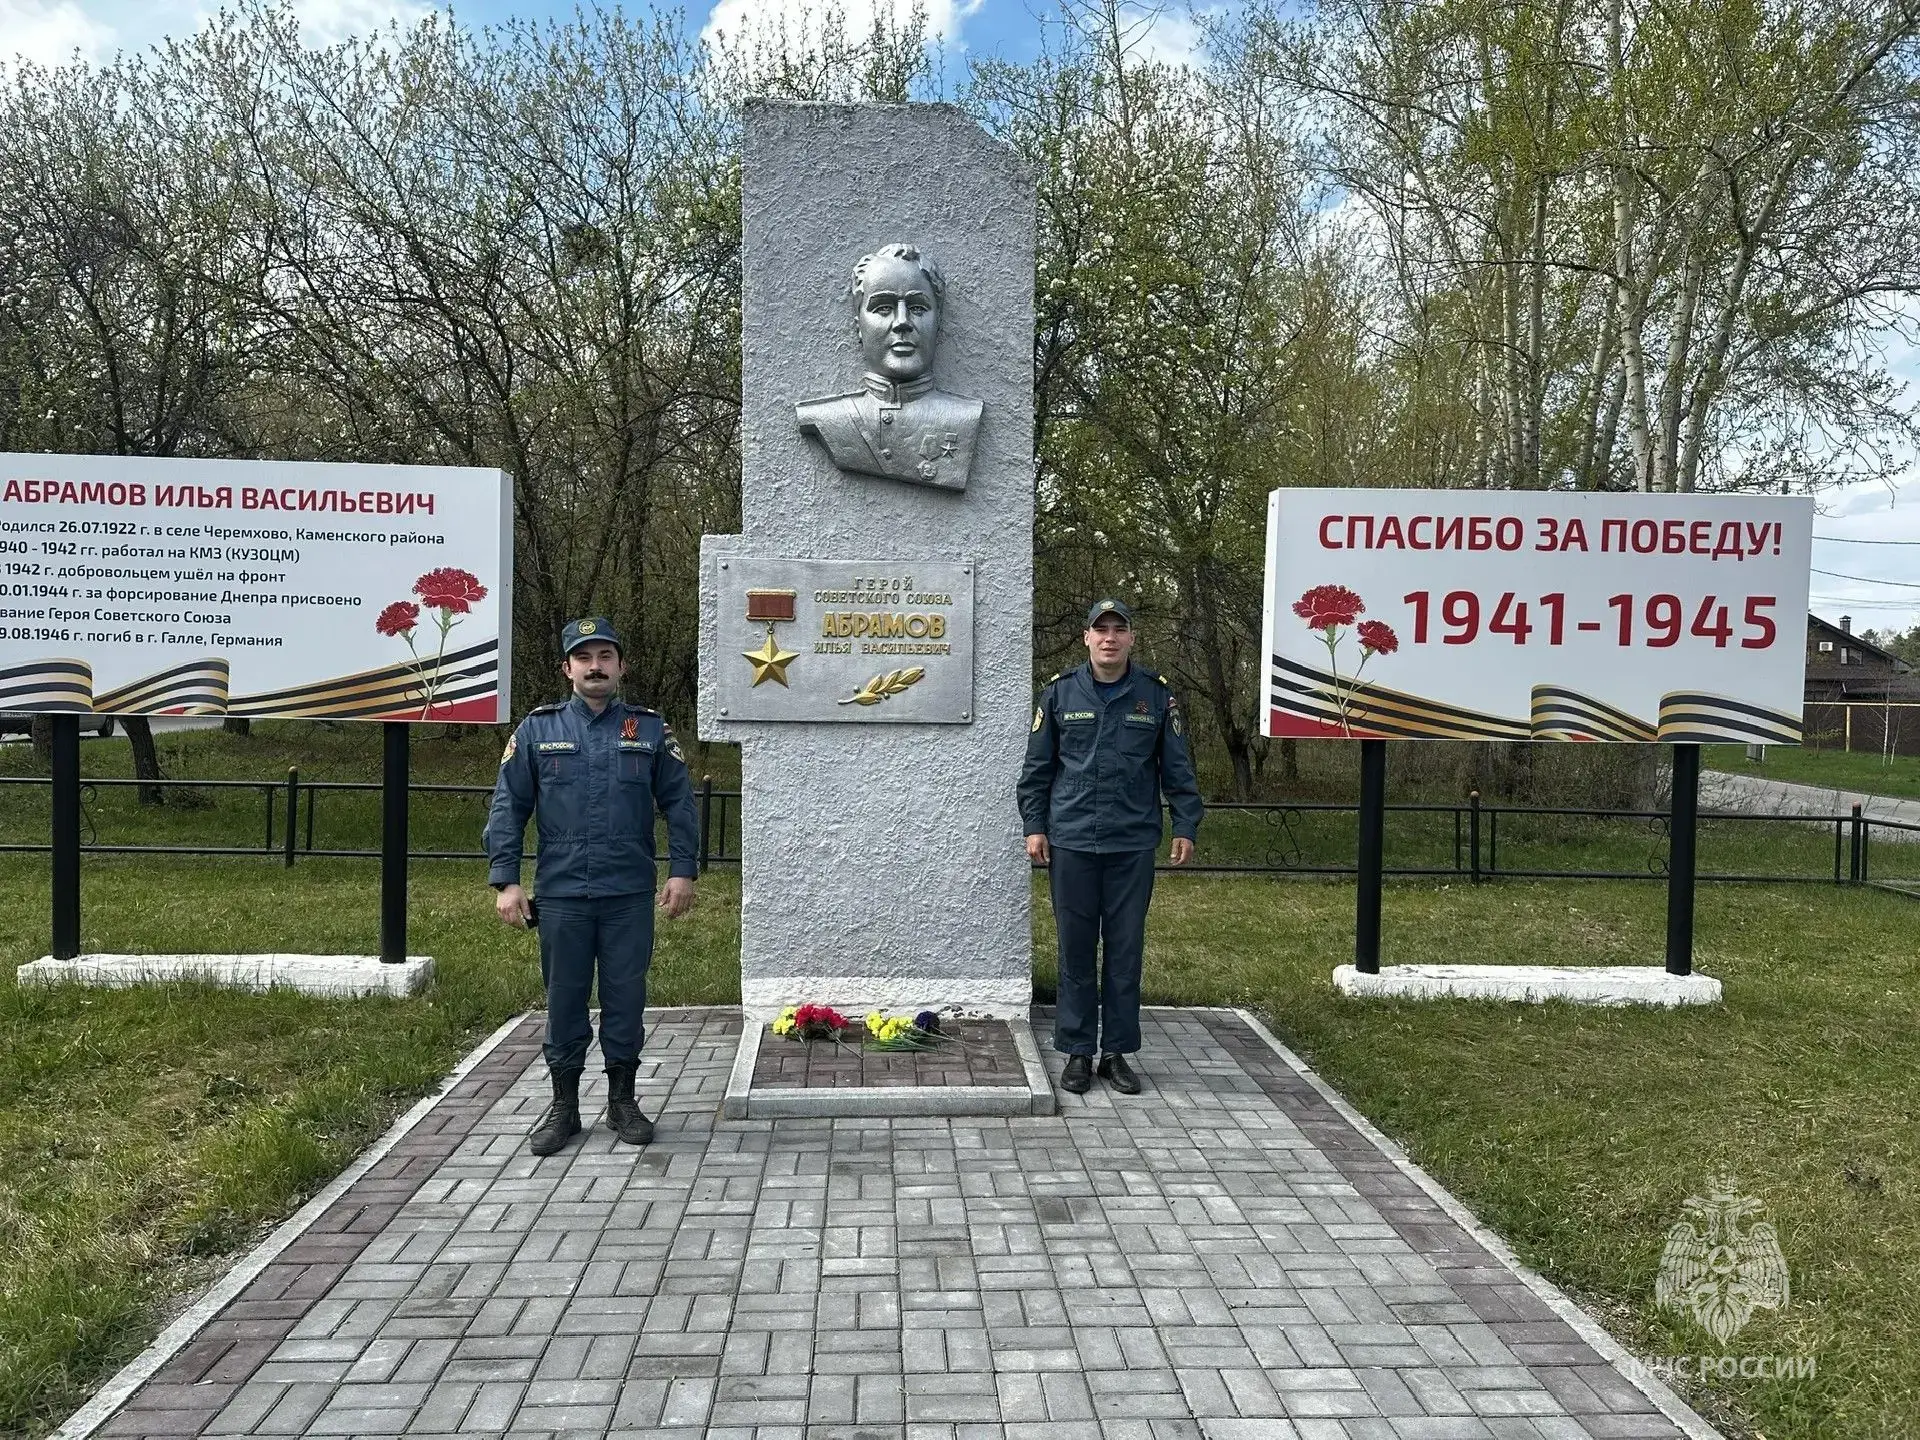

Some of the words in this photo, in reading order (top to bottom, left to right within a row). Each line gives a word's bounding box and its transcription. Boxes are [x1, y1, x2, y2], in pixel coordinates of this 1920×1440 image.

[3, 480, 147, 506] АБРАМОВ
[155, 484, 233, 509] ИЛЬЯ
[241, 487, 434, 515] ВАСИЛЬЕВИЧ
[0, 520, 55, 534] одился
[59, 520, 137, 535] 26.07.1922
[140, 526, 150, 536] г.
[154, 527, 163, 536] в
[167, 526, 201, 537] селе
[204, 525, 292, 542] Черемхово,
[296, 527, 387, 543] Каменского
[390, 531, 445, 547] района
[1319, 515, 1523, 550] СПАСИБО
[1534, 518, 1588, 552] ЗА
[1601, 519, 1782, 561] ПОБЕДУ!
[41, 542, 77, 555] 1942
[80, 546, 98, 556] гг.
[102, 543, 164, 559] работал
[167, 548, 186, 559] на
[190, 546, 222, 560] КМЗ
[225, 546, 300, 564] (КУЗОЦМ)
[5, 562, 41, 576] 1942
[44, 566, 54, 576] г.
[58, 564, 171, 581] добровольцем
[174, 567, 213, 583] ушёл
[217, 571, 235, 582] на
[238, 569, 286, 585] фронт
[853, 575, 913, 591] ГЕРОЙ
[72, 588, 82, 598] г.
[86, 589, 103, 599] за
[106, 586, 218, 604] форсирование
[220, 590, 278, 607] Днепра
[281, 594, 362, 608] присвоено
[813, 590, 900, 605] СОВЕТСКОГО
[906, 592, 953, 606] СОЮЗА
[48, 607, 90, 623] Героя
[94, 608, 180, 623] Советского
[183, 610, 232, 624] Союза
[822, 611, 946, 639] АБРАМОВ
[1403, 590, 1777, 651] 1941-1945
[73, 632, 84, 642] г.
[87, 630, 132, 643] погиб
[135, 633, 144, 643] в
[147, 634, 158, 644] г.
[161, 631, 207, 647] Галле,
[211, 632, 283, 649] Германия
[813, 641, 852, 654] ИЛЬЯ
[860, 642, 952, 656] ВАСИЛЬЕВИЧ
